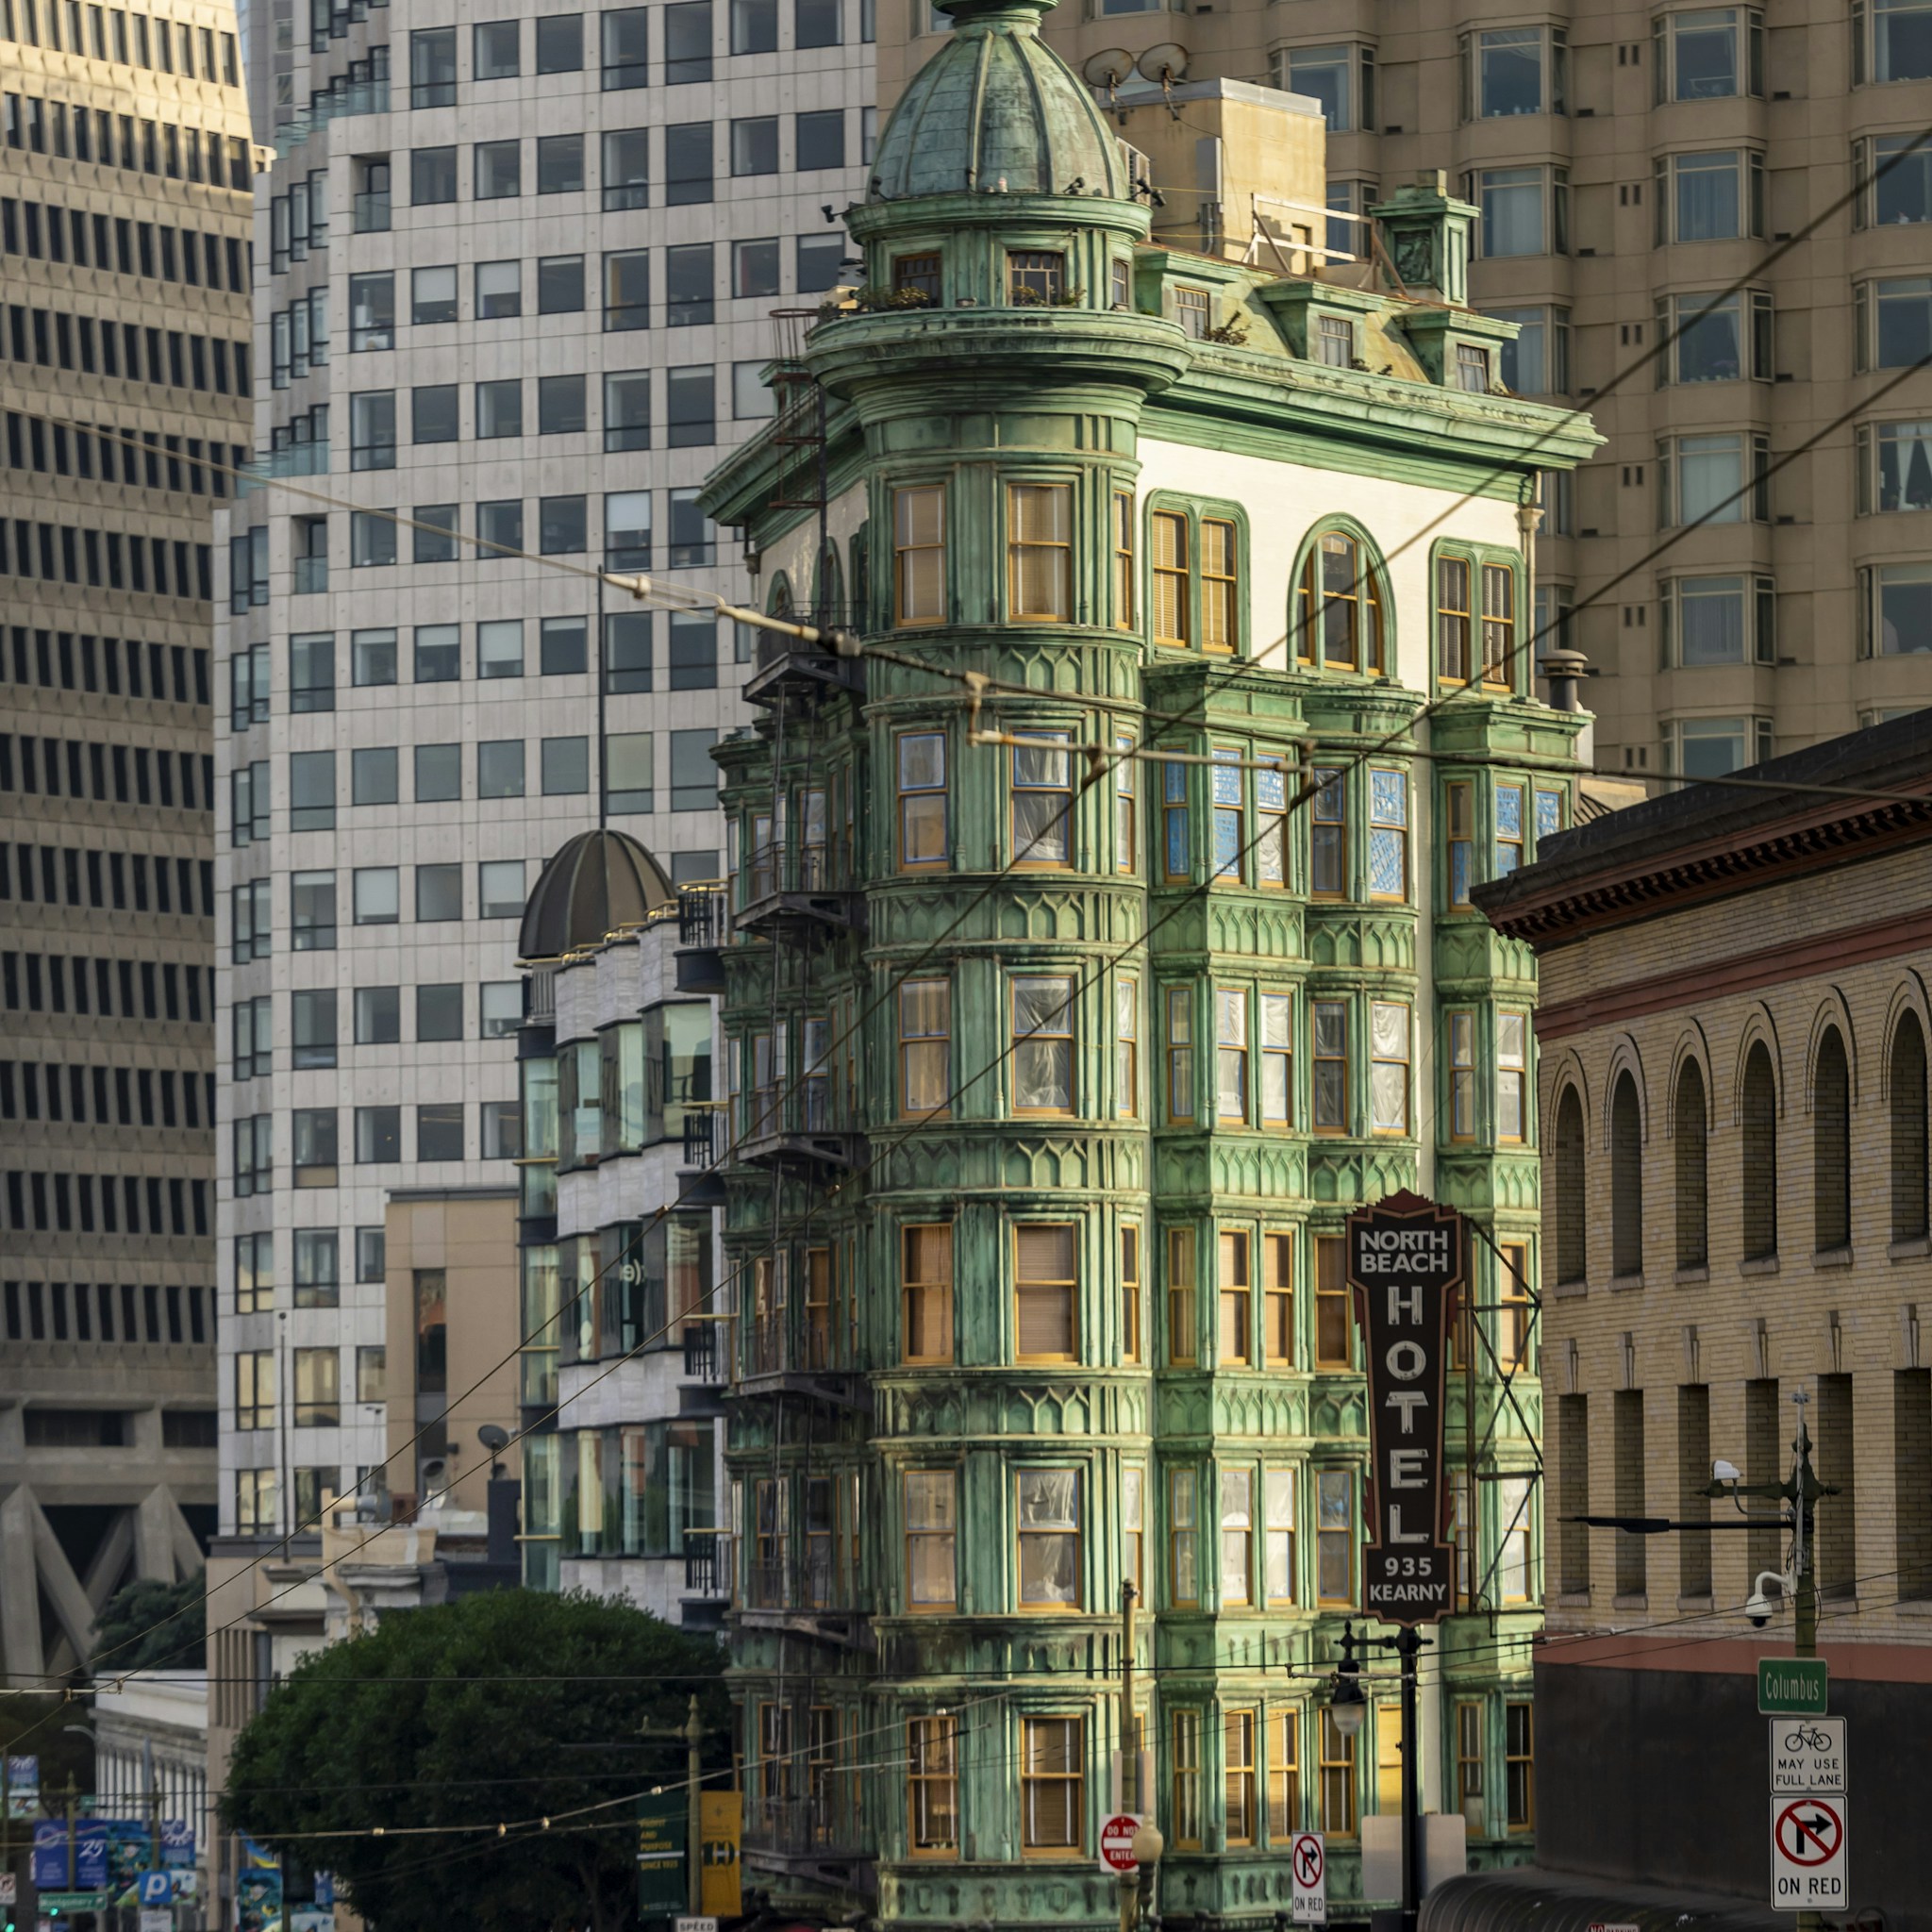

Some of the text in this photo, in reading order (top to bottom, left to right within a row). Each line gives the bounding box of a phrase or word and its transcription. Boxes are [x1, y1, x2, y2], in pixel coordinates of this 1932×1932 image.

[1359, 1230, 1448, 1252] NORTH
[1360, 1253, 1448, 1273] BEACH
[1385, 1286, 1430, 1543] HOTEL
[1385, 1557, 1432, 1576] 935
[1369, 1583, 1446, 1601] KEARNY
[1765, 1672, 1819, 1701] Columbus
[1777, 1757, 1840, 1771] MAY USE
[1775, 1774, 1841, 1787] FULL LANE
[1107, 1825, 1119, 1836] DO
[1777, 1877, 1841, 1895] ON RED
[1294, 1896, 1323, 1911] ON RED
[679, 1923, 714, 1932] SPEED
